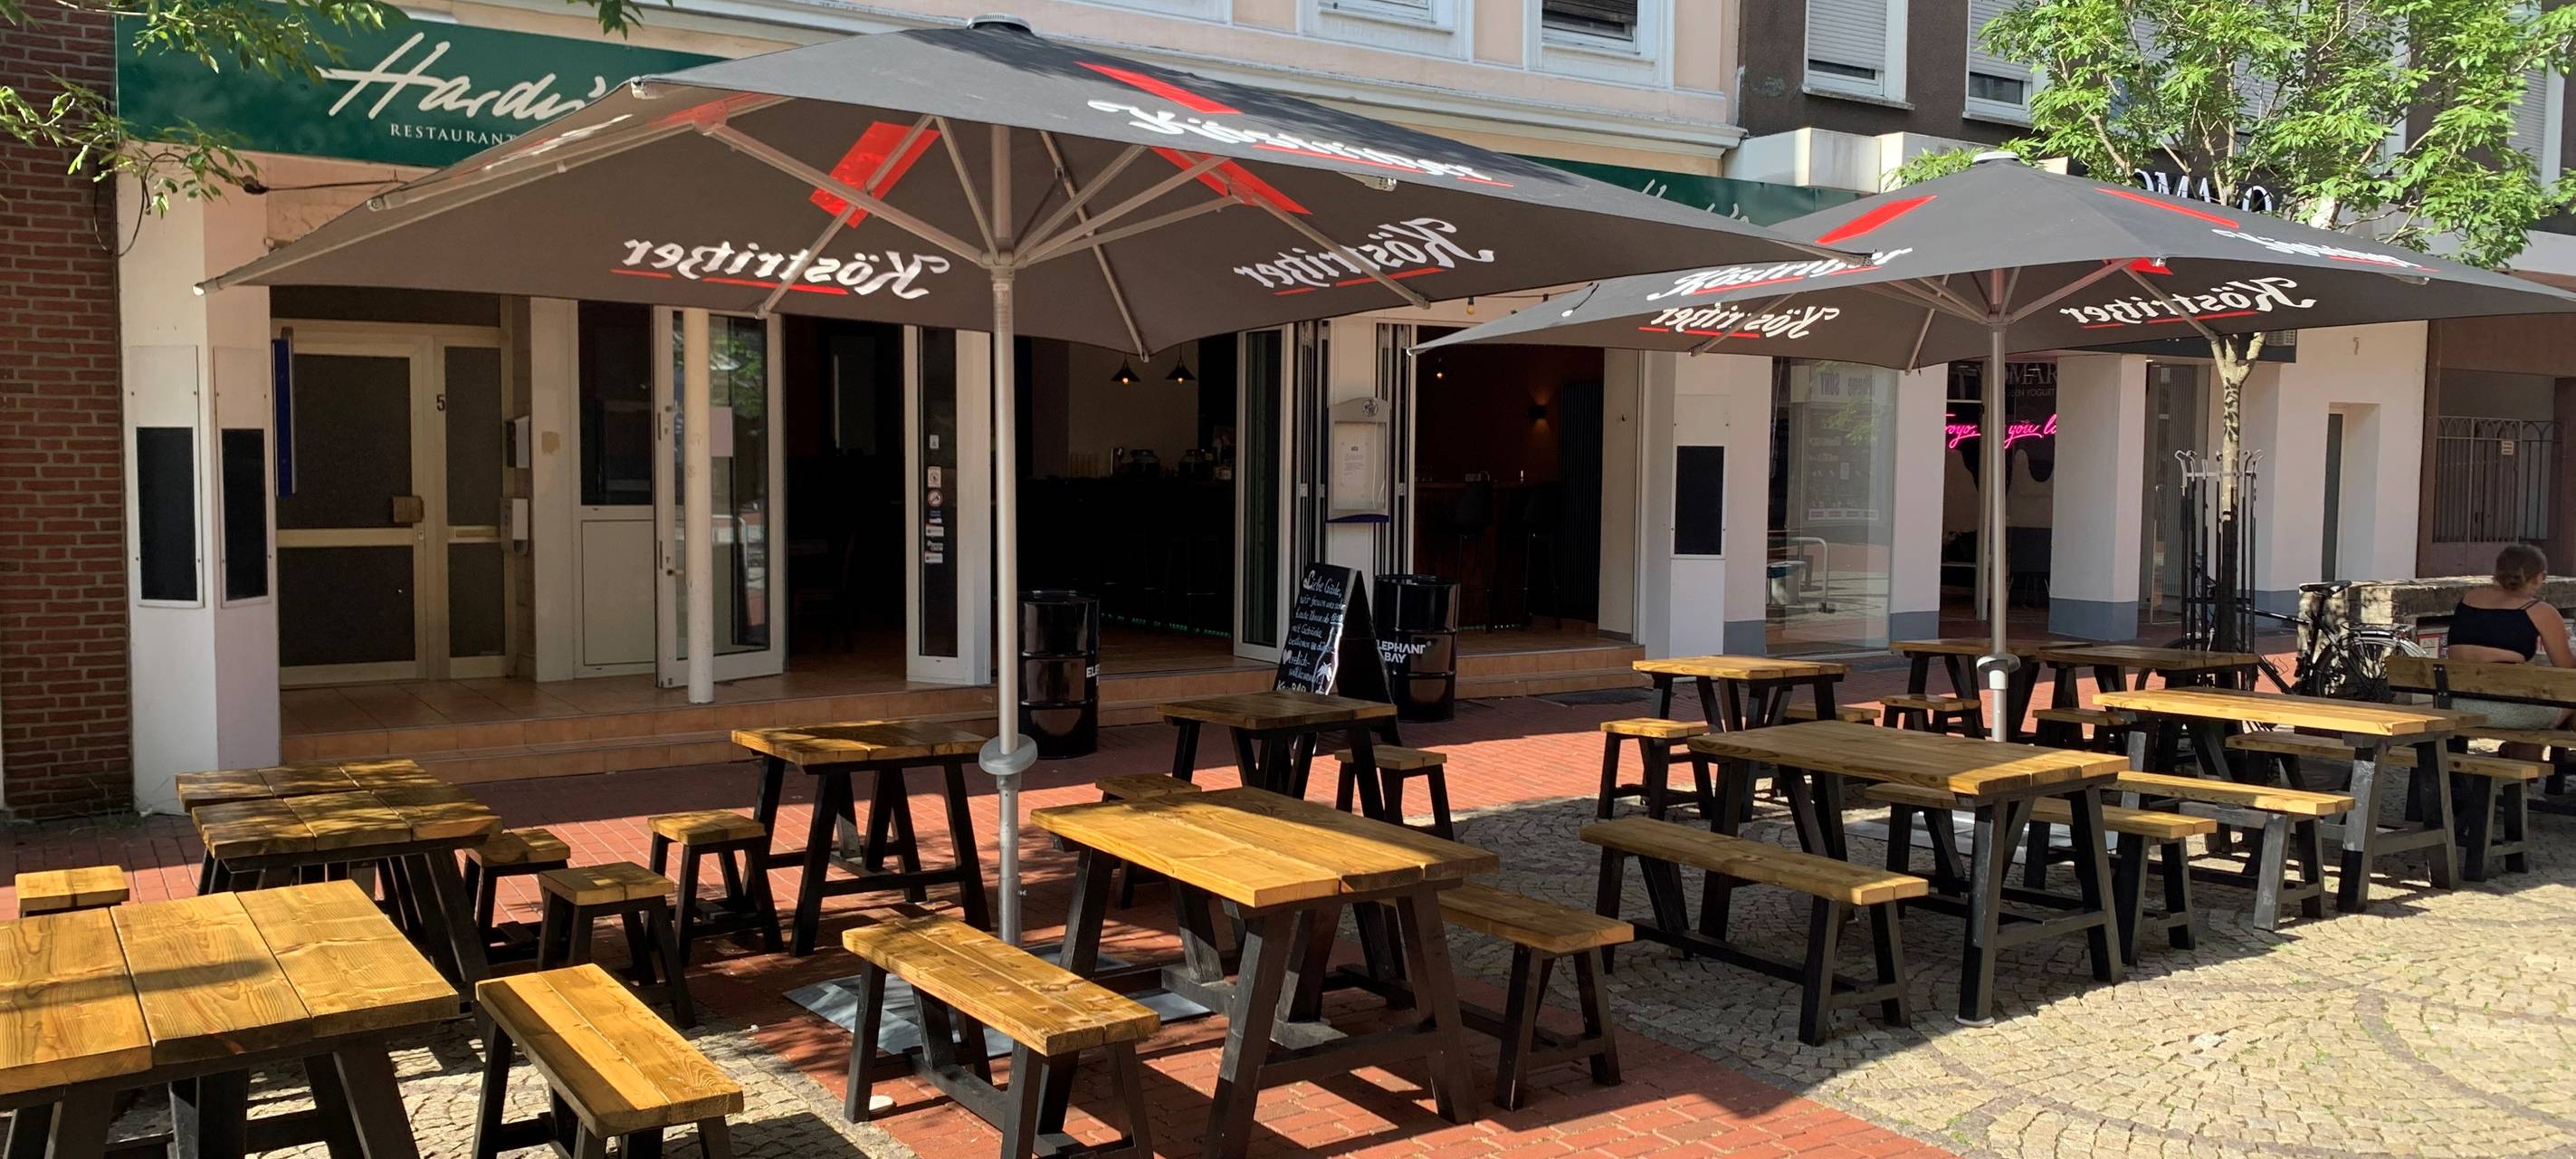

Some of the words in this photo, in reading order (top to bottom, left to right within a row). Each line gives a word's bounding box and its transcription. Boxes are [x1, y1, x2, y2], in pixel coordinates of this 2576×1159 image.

[436, 394, 446, 411] 5
[1303, 570, 1324, 592] Liebe
[1376, 639, 1426, 655] LEPHANT
[1384, 652, 1407, 664] BAY
